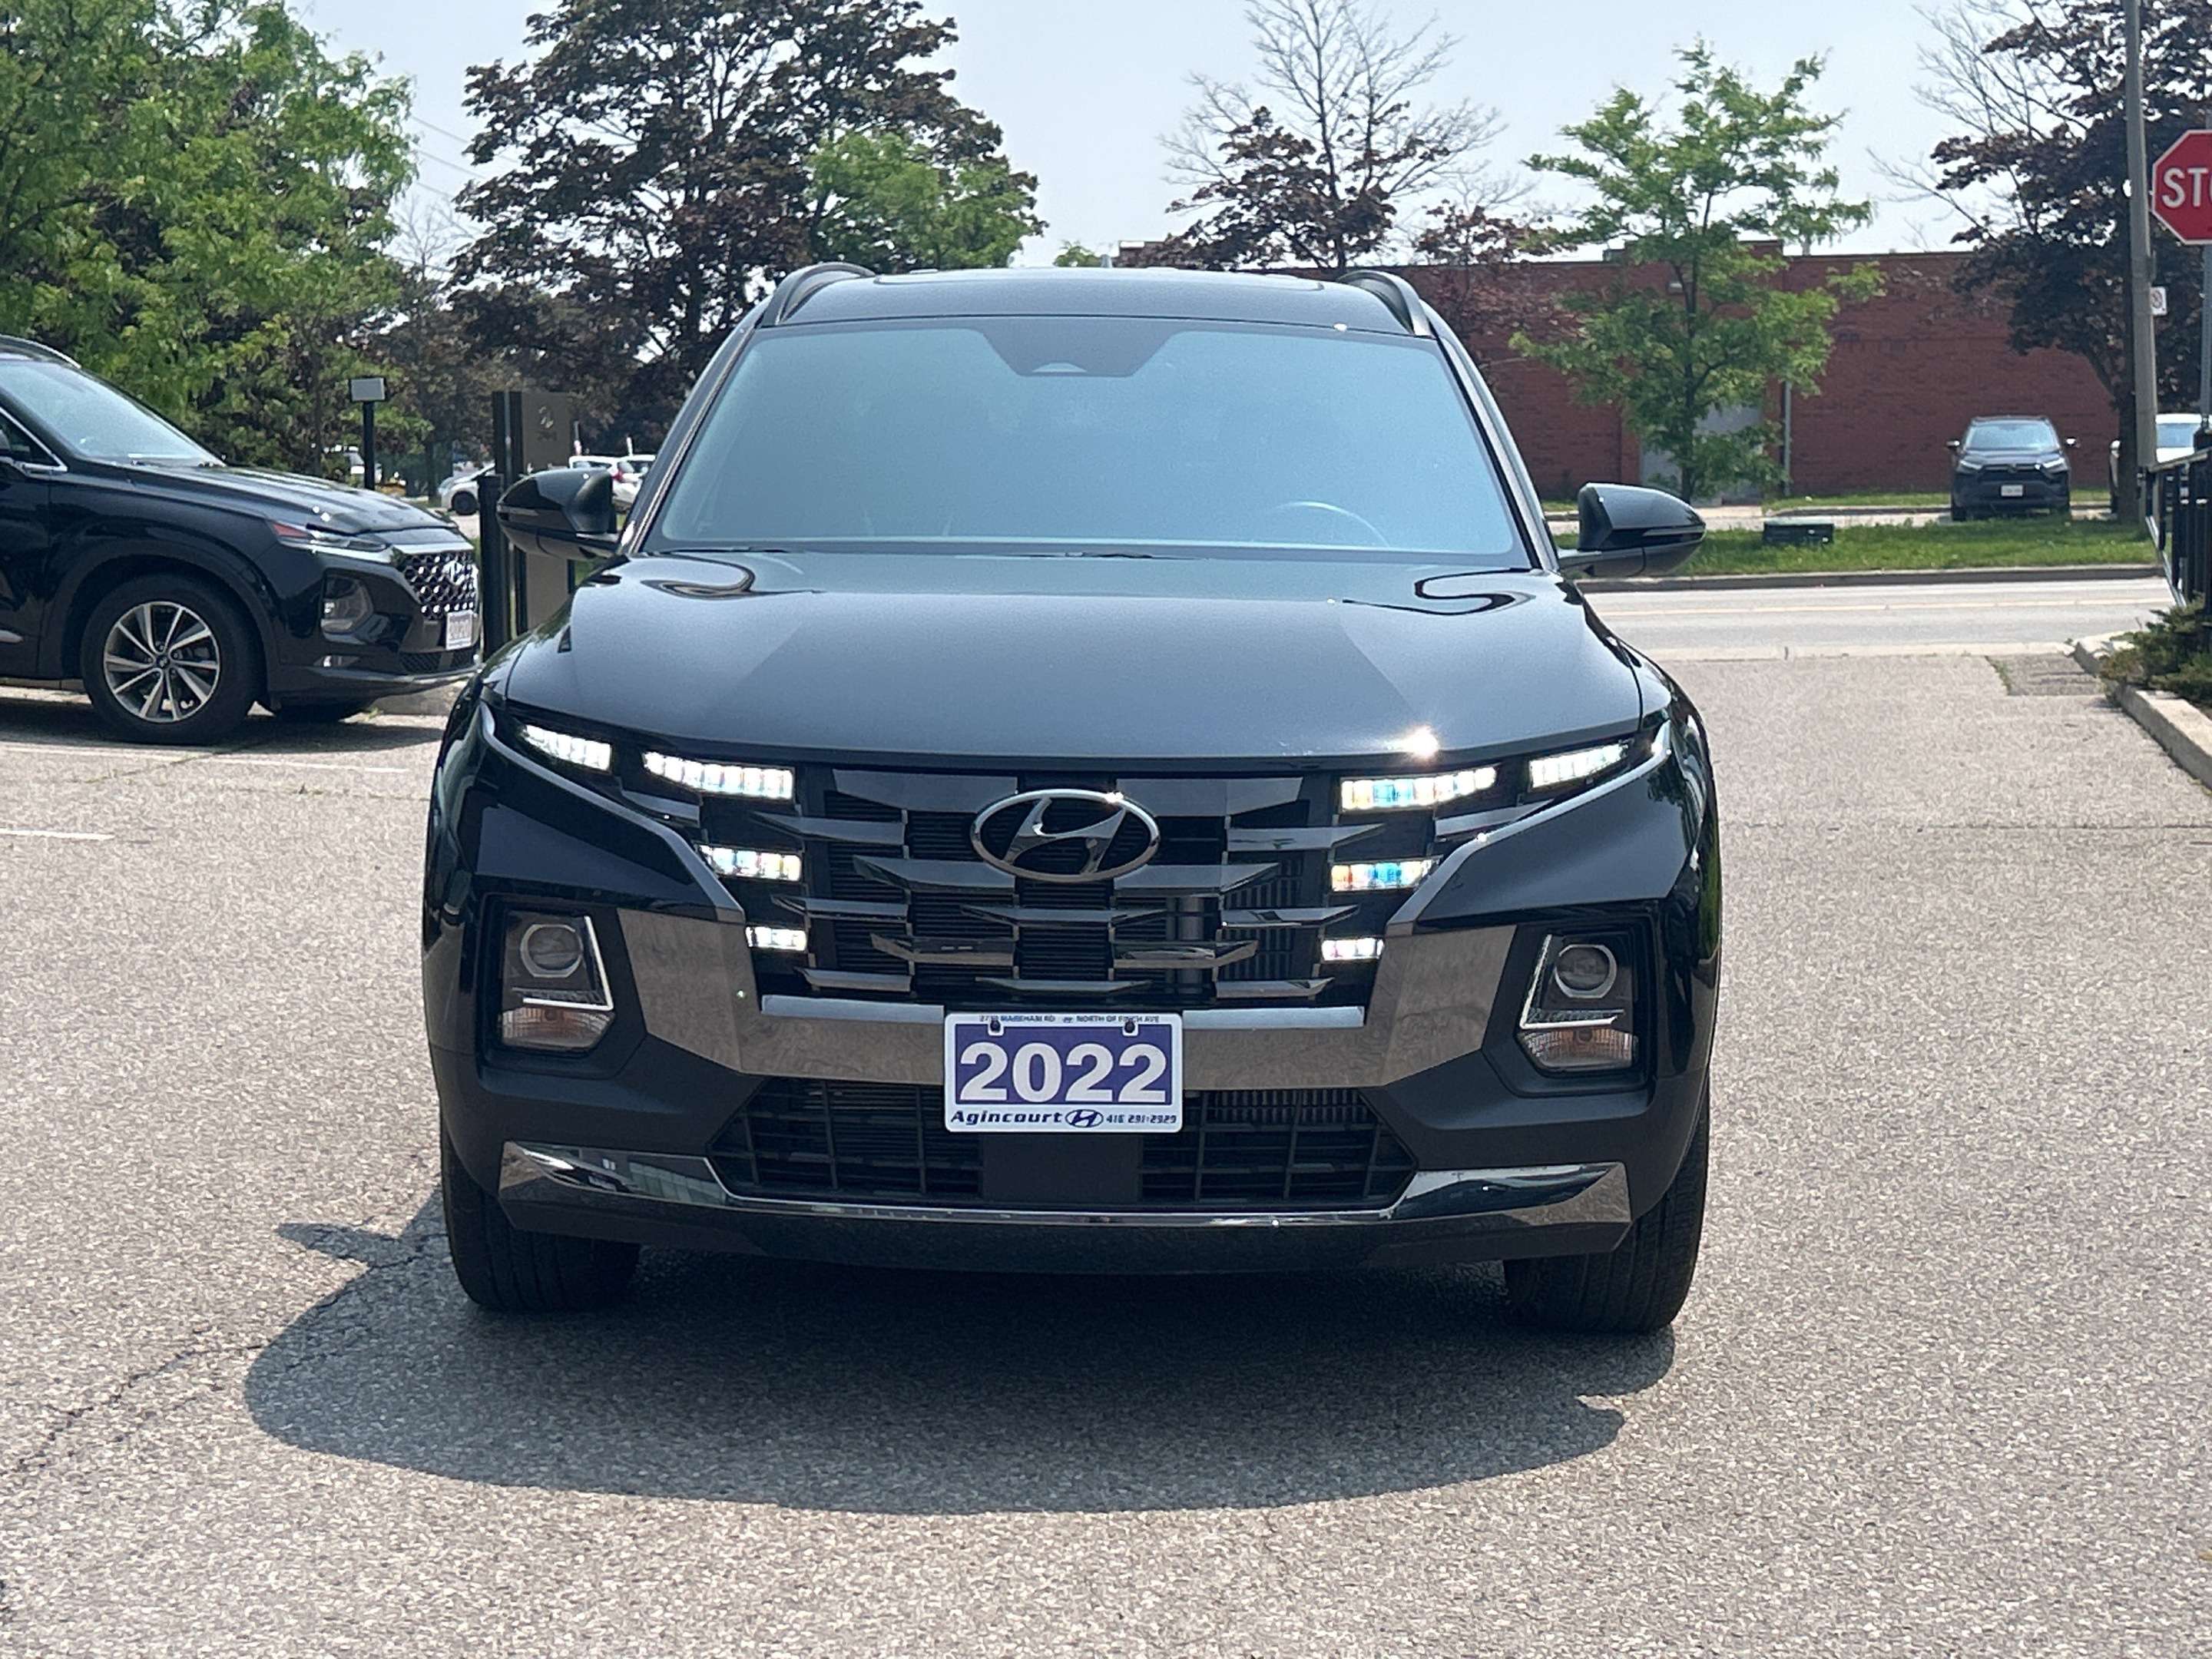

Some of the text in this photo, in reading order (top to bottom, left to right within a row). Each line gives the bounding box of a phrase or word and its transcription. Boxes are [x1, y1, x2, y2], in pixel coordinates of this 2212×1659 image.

[2161, 167, 2212, 208] ST
[959, 1041, 1167, 1103] 2022
[950, 1110, 1062, 1125] Agincourt
